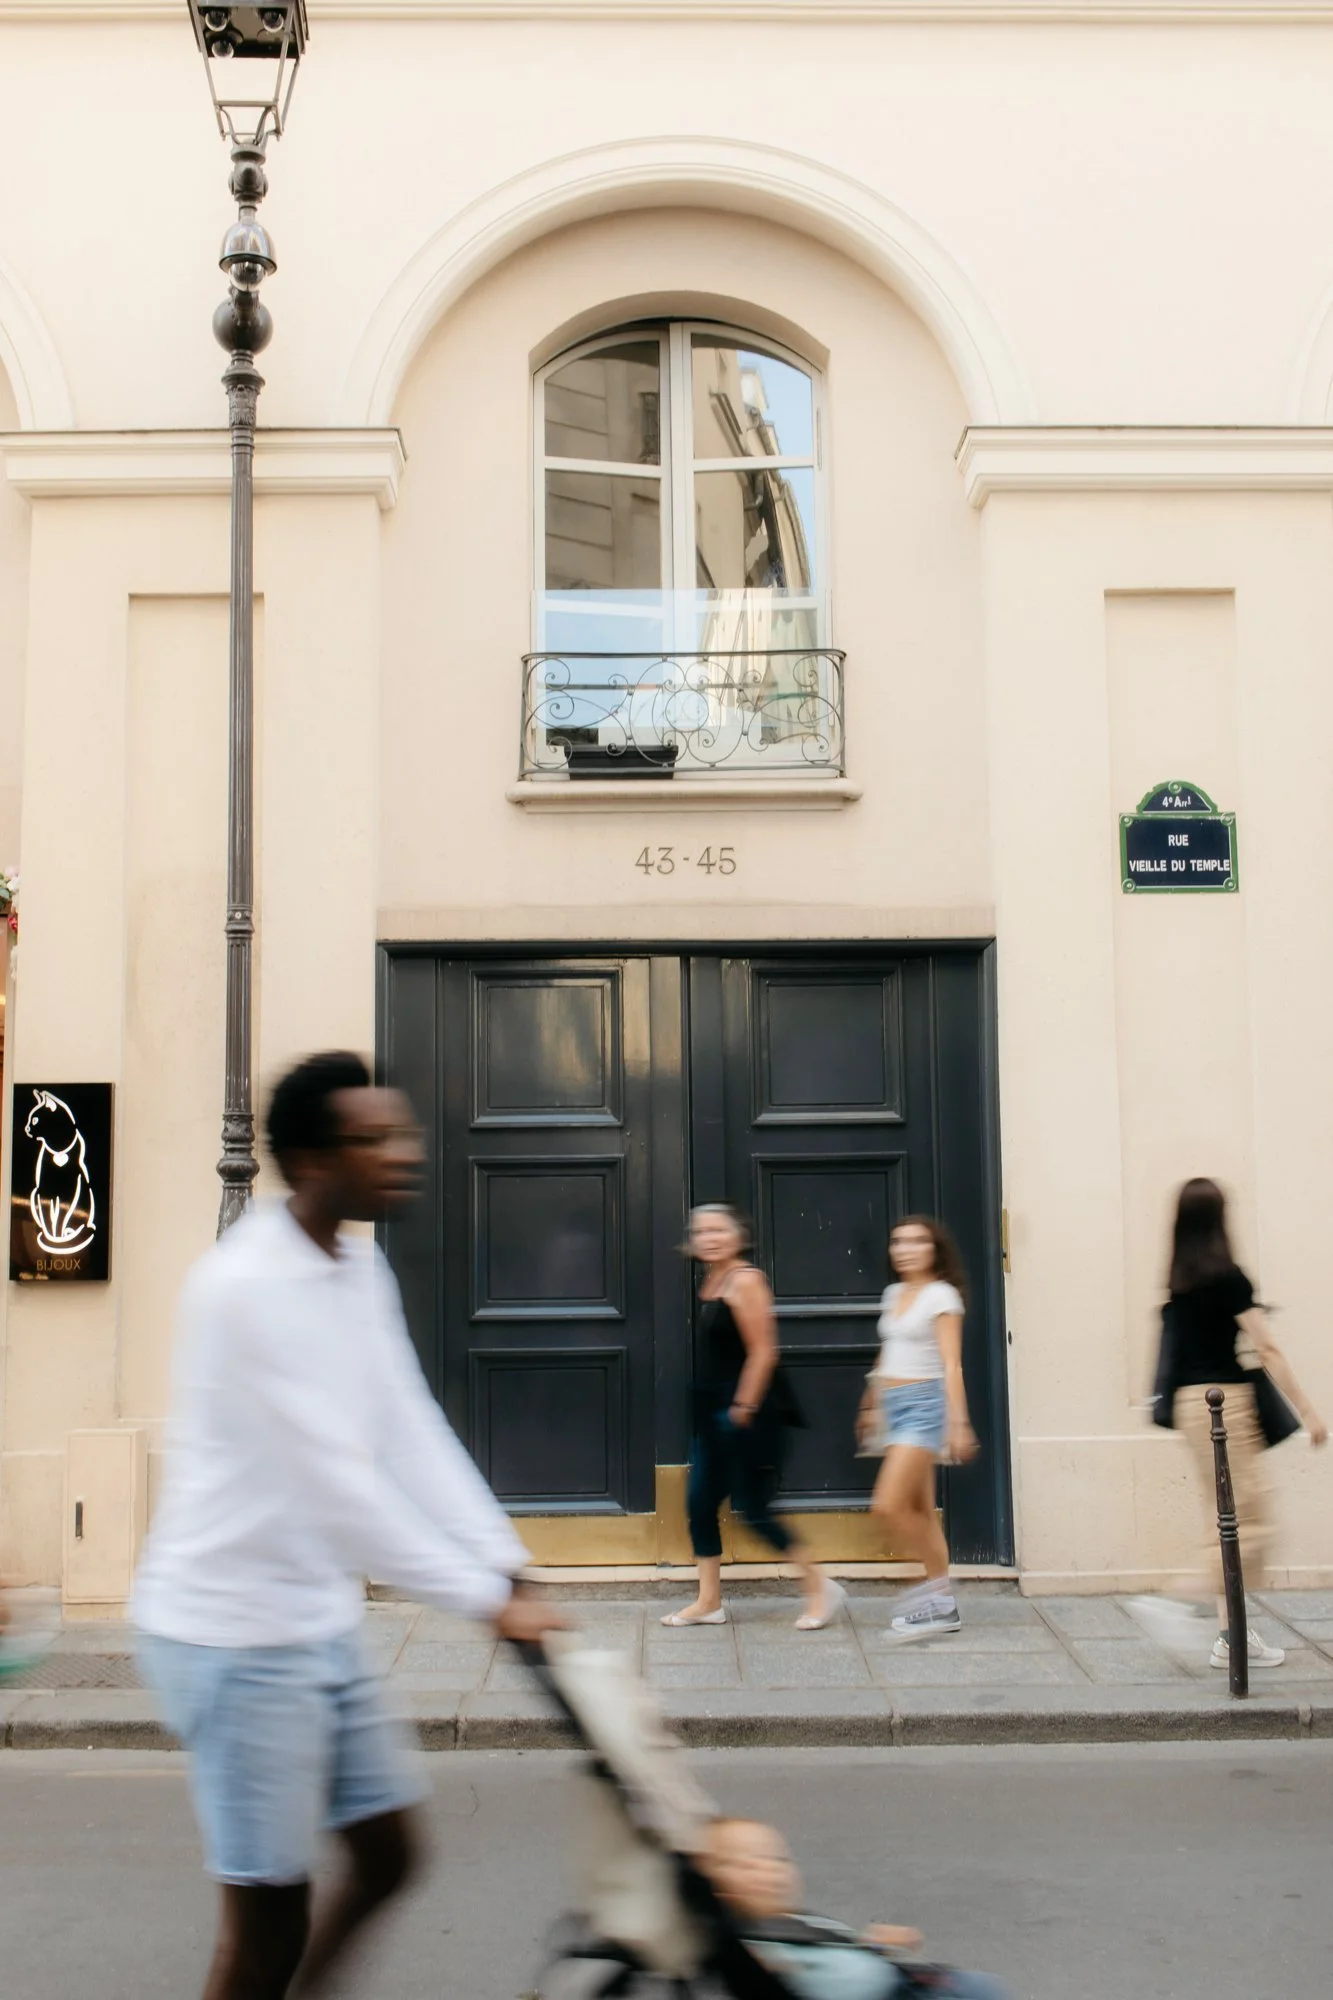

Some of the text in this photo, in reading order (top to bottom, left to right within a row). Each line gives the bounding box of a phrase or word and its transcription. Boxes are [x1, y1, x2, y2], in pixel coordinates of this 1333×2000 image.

[1168, 834, 1189, 846] RUE
[1129, 859, 1231, 872] VIEILLE DU TEMPLE
[36, 1259, 81, 1271] BIJOUX
